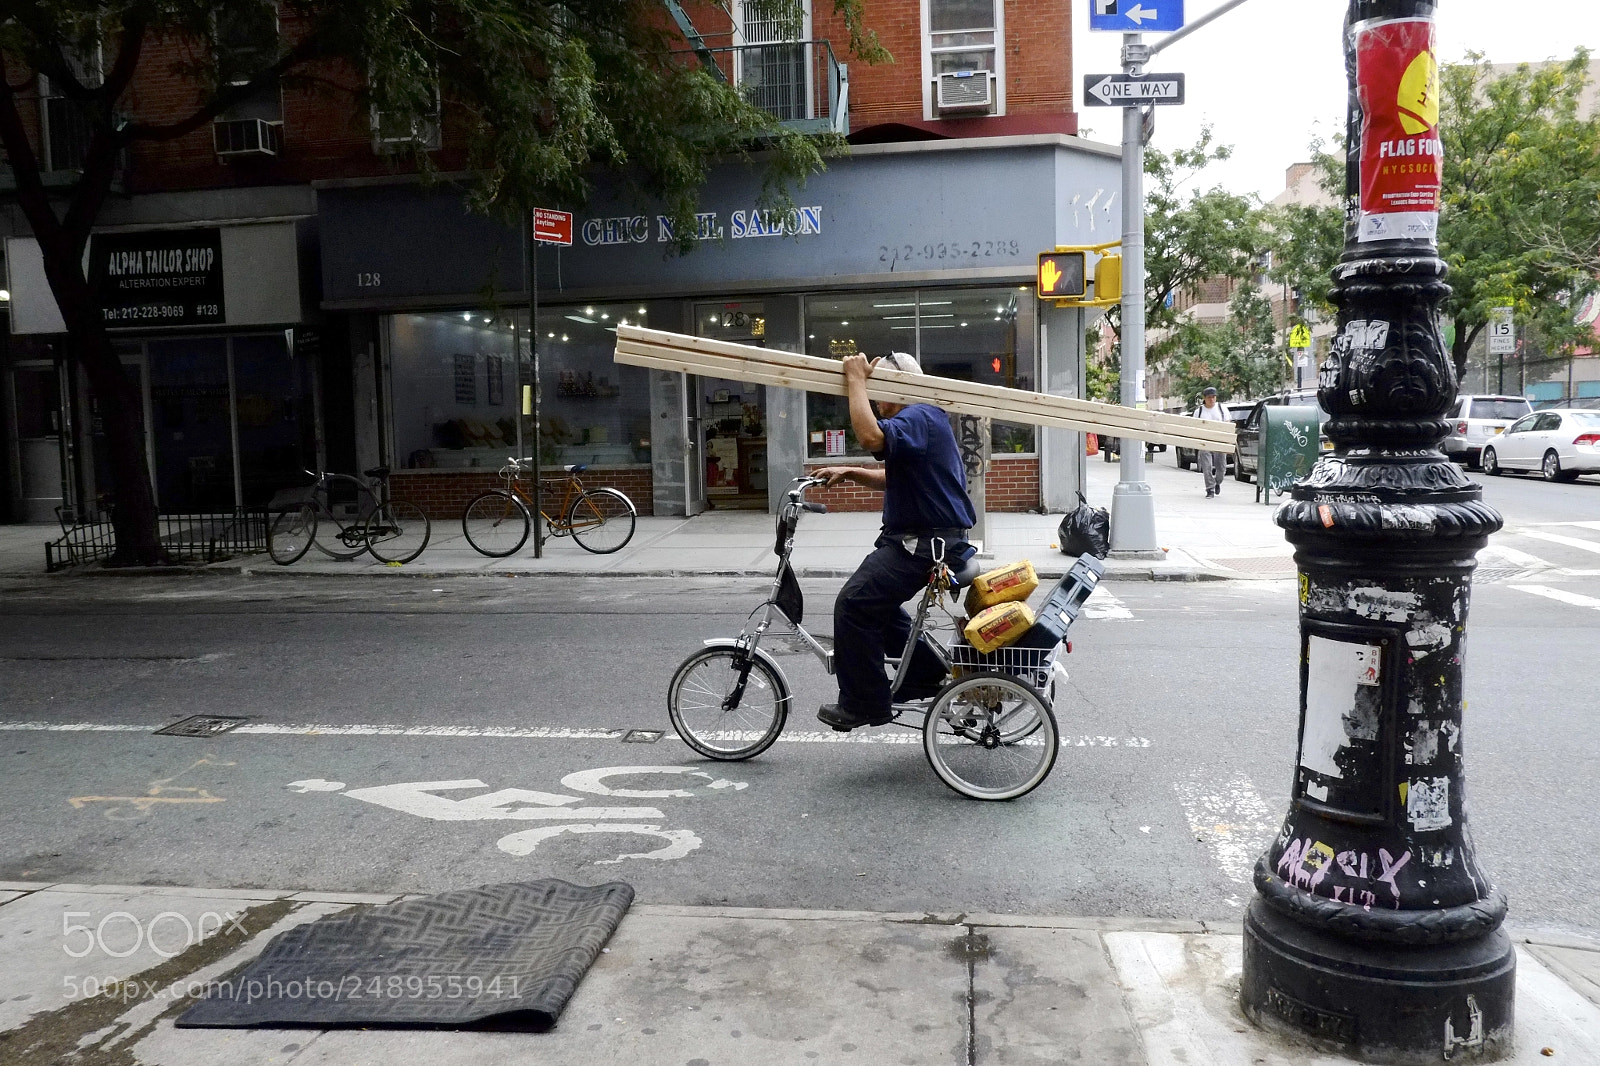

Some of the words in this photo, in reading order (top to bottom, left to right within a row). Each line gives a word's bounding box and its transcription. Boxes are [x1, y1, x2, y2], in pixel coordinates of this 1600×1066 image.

[1102, 83, 1132, 97] ONE
[1140, 83, 1171, 96] WAY
[1380, 139, 1416, 159] FLAG
[536, 219, 556, 227] Anytime
[544, 212, 566, 222] STANDING
[581, 215, 649, 246] CHIC
[657, 213, 724, 242] NIL
[731, 206, 822, 239] SALON
[109, 251, 143, 276] ALPHA
[145, 249, 183, 274] TAILOR
[185, 248, 214, 272] SHOP
[119, 278, 171, 289] ALTERATION
[172, 276, 207, 287] EXPERT
[357, 272, 381, 287] 128
[102, 308, 120, 320] Tel:
[122, 306, 184, 319] 212-228-9069
[196, 305, 218, 316] #128
[717, 311, 745, 328] 128
[1494, 323, 1510, 335] 15
